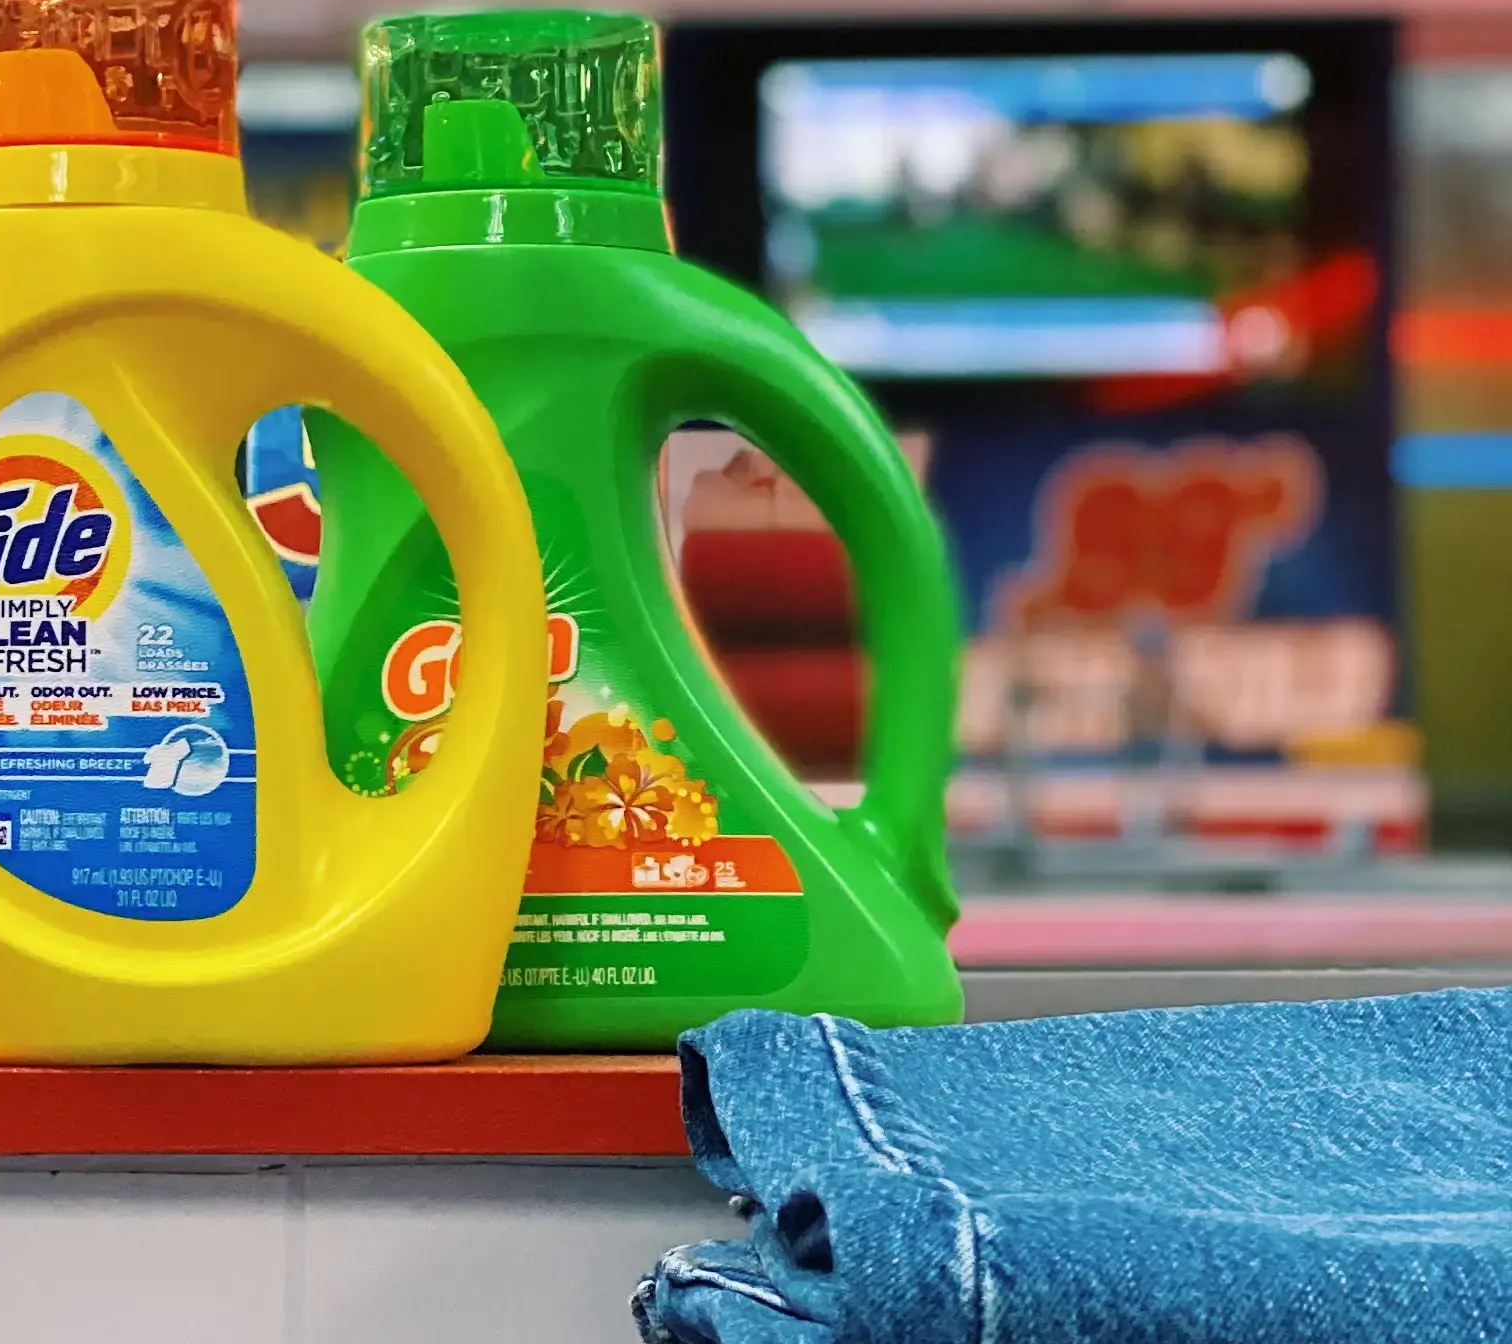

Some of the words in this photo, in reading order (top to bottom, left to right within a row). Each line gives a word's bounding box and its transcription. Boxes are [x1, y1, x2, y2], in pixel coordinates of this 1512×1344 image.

[138, 624, 173, 645] 22
[138, 648, 183, 658] LOADS
[30, 686, 74, 699] ODOR
[77, 686, 113, 699] OUT.
[132, 686, 168, 699] LOW
[30, 700, 83, 712] ODEUR
[131, 700, 163, 712] BAS
[166, 700, 206, 713] PRIX.
[714, 861, 736, 876] 25
[72, 867, 90, 885] 917
[116, 889, 128, 907] 31
[131, 889, 143, 907] FL
[591, 967, 606, 986] 40
[607, 966, 620, 986] FL
[621, 966, 637, 986] OZ
